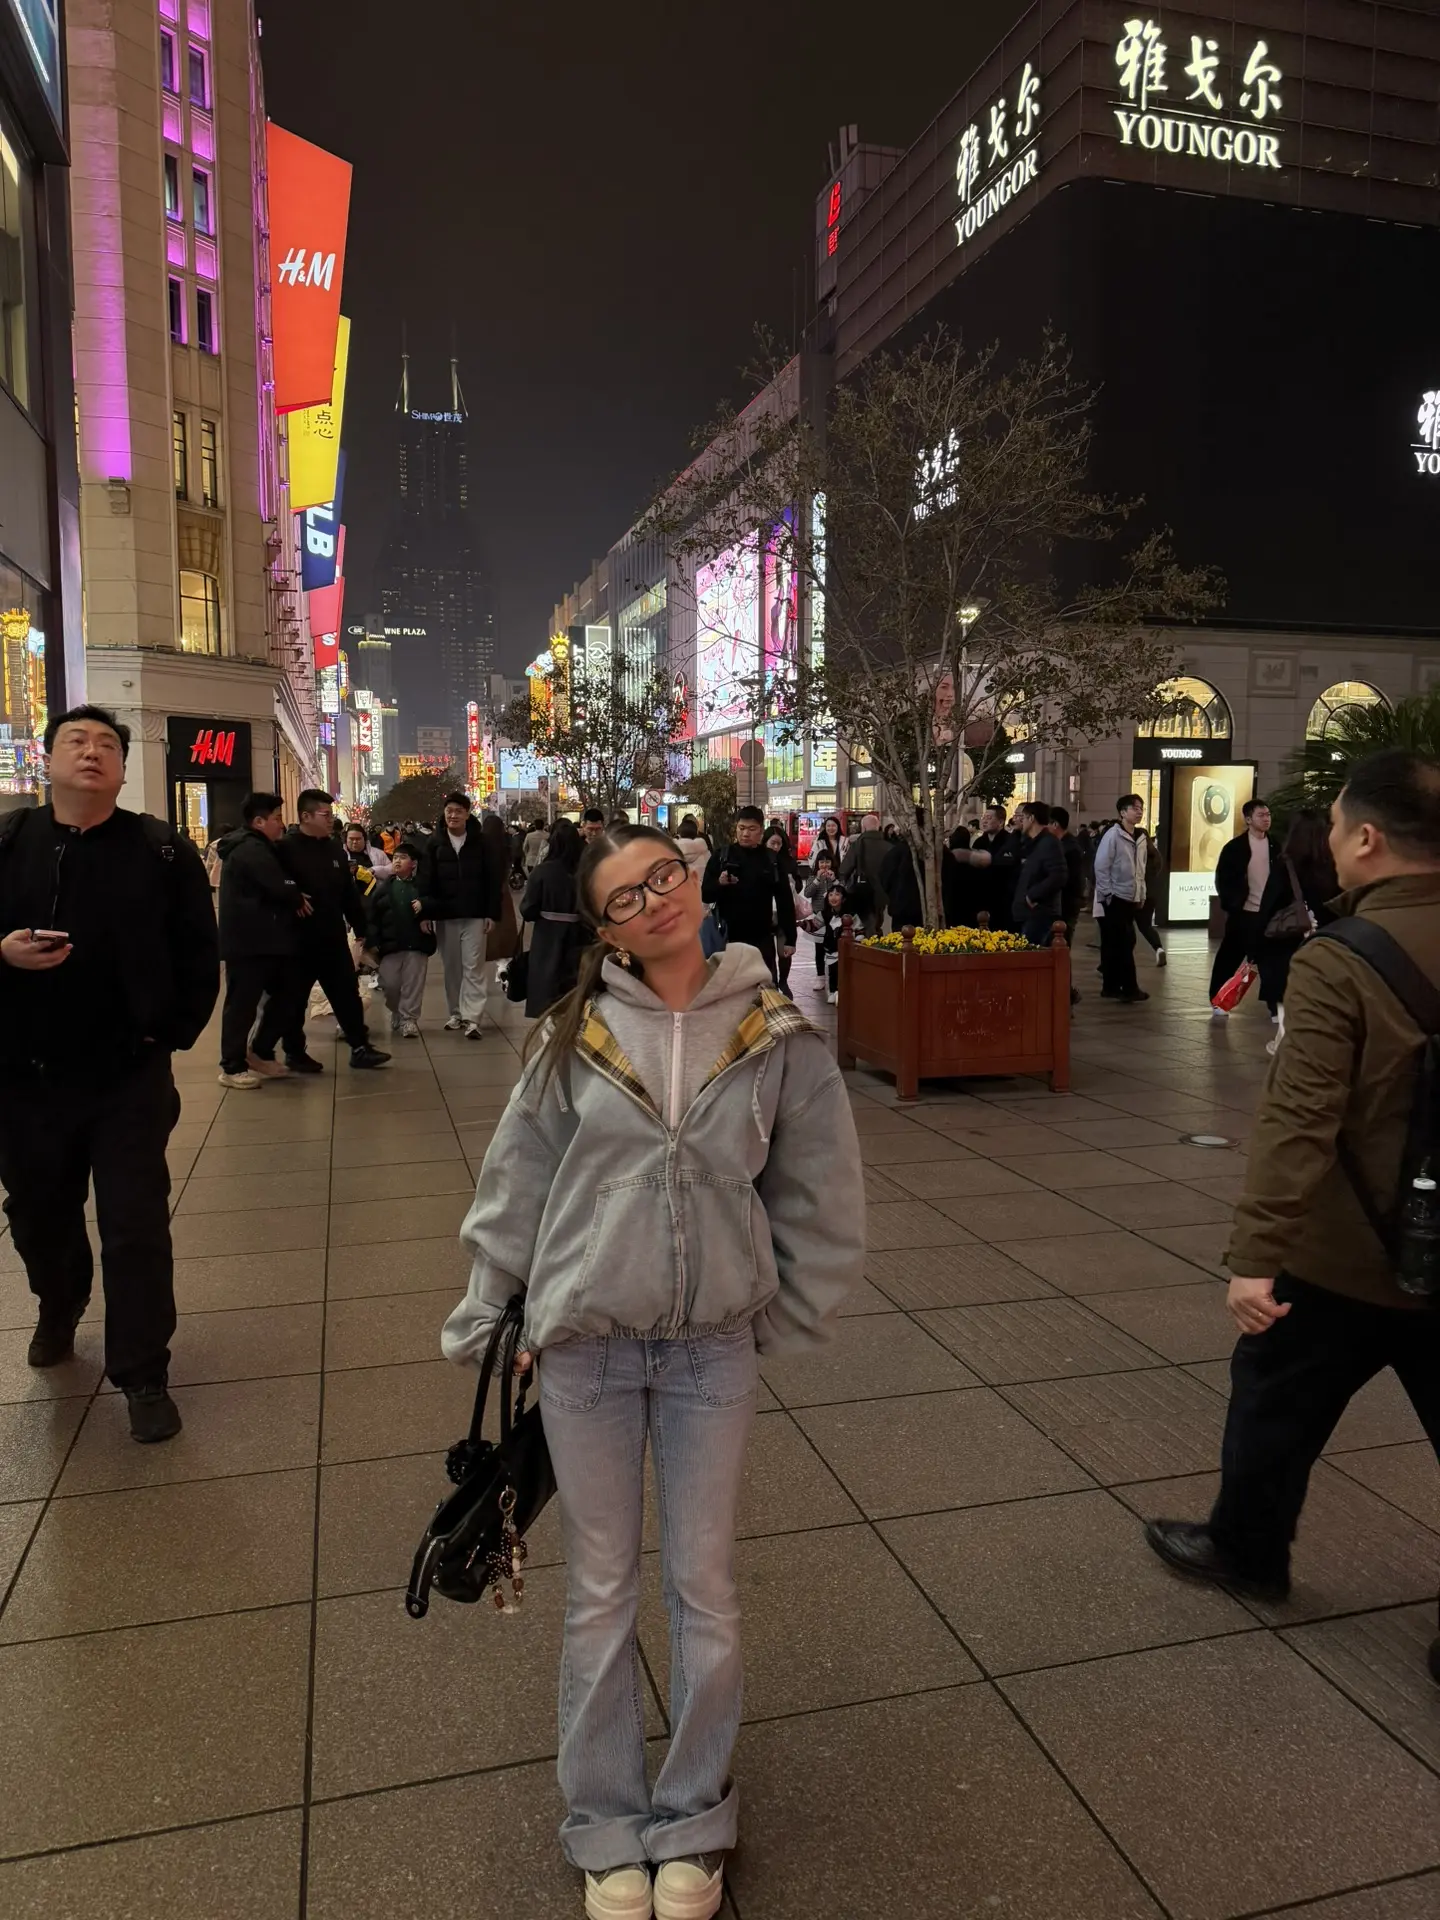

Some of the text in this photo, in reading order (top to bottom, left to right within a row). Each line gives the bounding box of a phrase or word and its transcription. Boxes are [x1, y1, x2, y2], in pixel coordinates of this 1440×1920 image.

[1115, 19, 1283, 119] 雅戈尔
[957, 62, 1040, 205] 雅戈尔
[1113, 110, 1282, 168] YOUNGOR
[954, 149, 1039, 247] YOUNGOR
[277, 247, 336, 291] H&M
[313, 402, 335, 439] 点心
[306, 502, 334, 558] LB
[402, 627, 427, 636] PLAZA
[189, 729, 236, 766] H&M
[359, 715, 372, 746] KFC
[371, 708, 381, 761] BOSIDENG
[1160, 748, 1202, 759] YOUNGOR
[1178, 884, 1207, 892] HUAWEI
